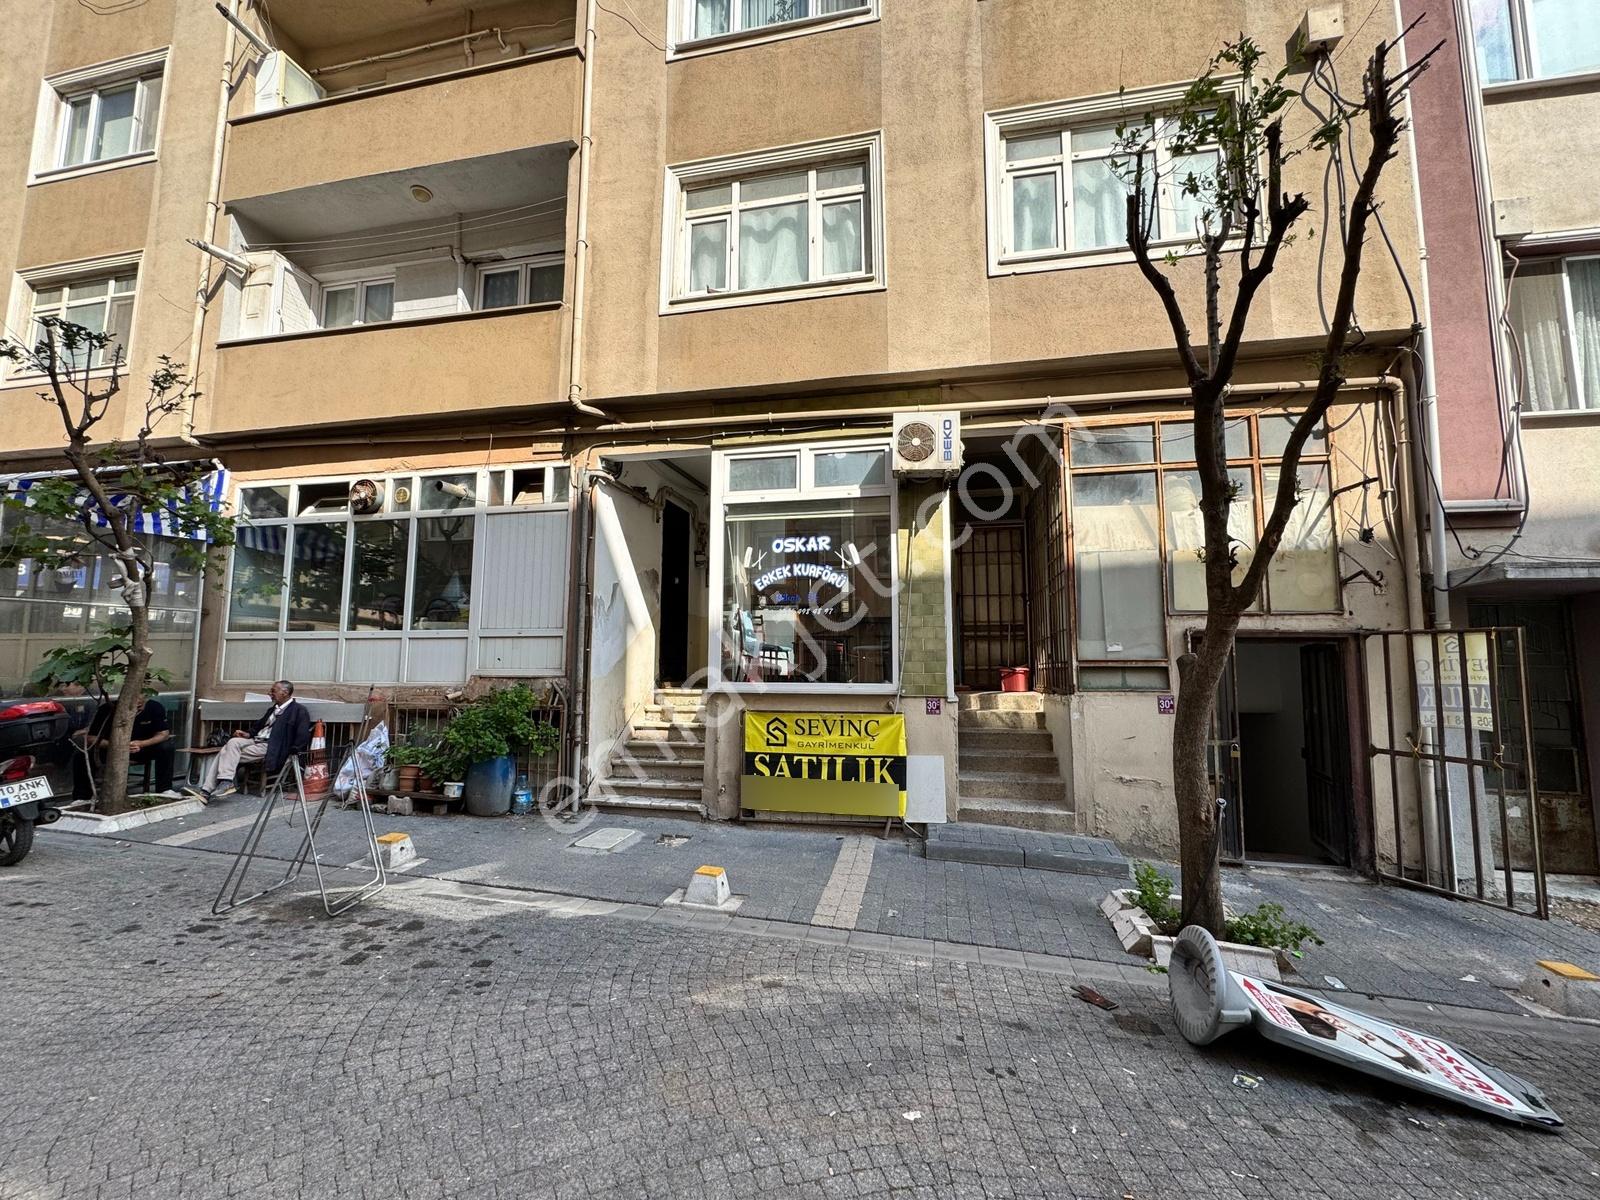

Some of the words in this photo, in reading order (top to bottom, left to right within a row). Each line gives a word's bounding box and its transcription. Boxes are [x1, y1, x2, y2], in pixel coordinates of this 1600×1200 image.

[943, 419, 952, 461] BEKO
[771, 535, 832, 554] OSKAR
[753, 565, 791, 592] ERKEK
[793, 562, 848, 589] KUAFÖRÜ
[794, 715, 880, 741] SEVİNÇ
[797, 739, 875, 750] GAYRİMENKUL
[753, 753, 897, 785] SATILIK
[0, 786, 15, 796] 10
[18, 779, 45, 792] ANK
[13, 791, 38, 803] 338
[1421, 1038, 1514, 1106] OSCAR
